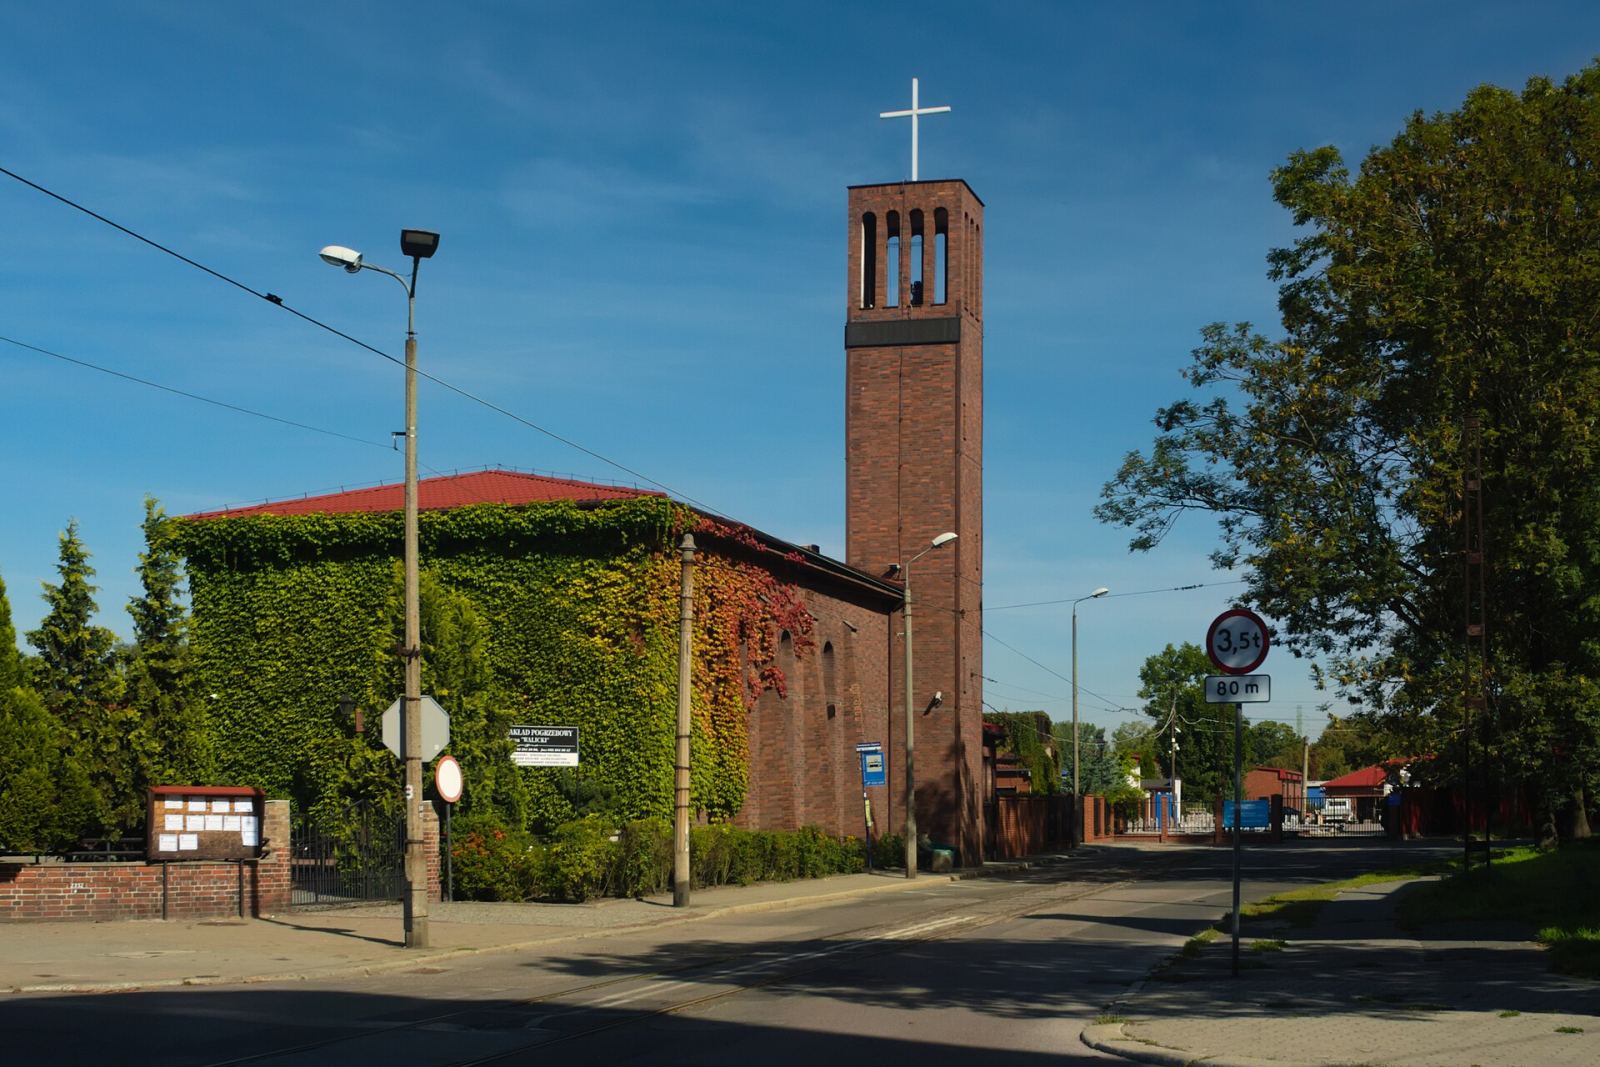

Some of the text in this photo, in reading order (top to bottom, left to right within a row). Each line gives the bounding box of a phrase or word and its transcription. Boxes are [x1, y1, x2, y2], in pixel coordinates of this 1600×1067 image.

[1217, 681, 1259, 696] 80 m
[531, 729, 573, 737] POGRZEBOWY
